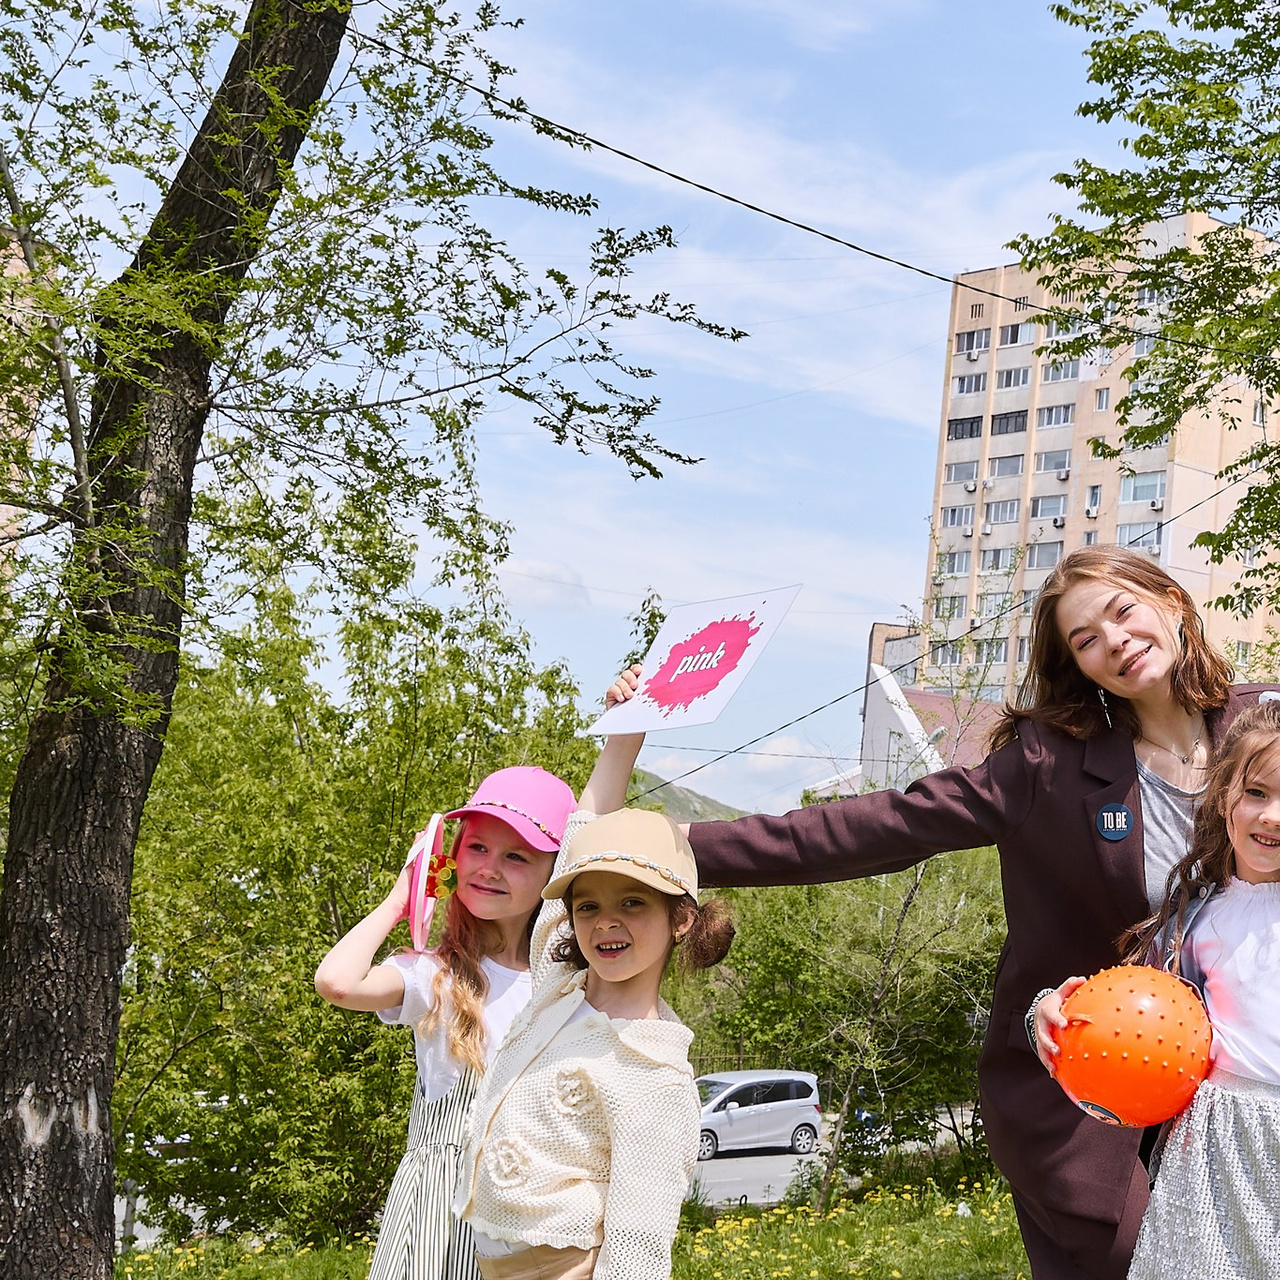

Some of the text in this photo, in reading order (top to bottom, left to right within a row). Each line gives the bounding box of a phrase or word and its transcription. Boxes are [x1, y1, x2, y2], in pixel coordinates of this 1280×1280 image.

[668, 641, 726, 683] pink
[1102, 811, 1127, 829] TO BE
